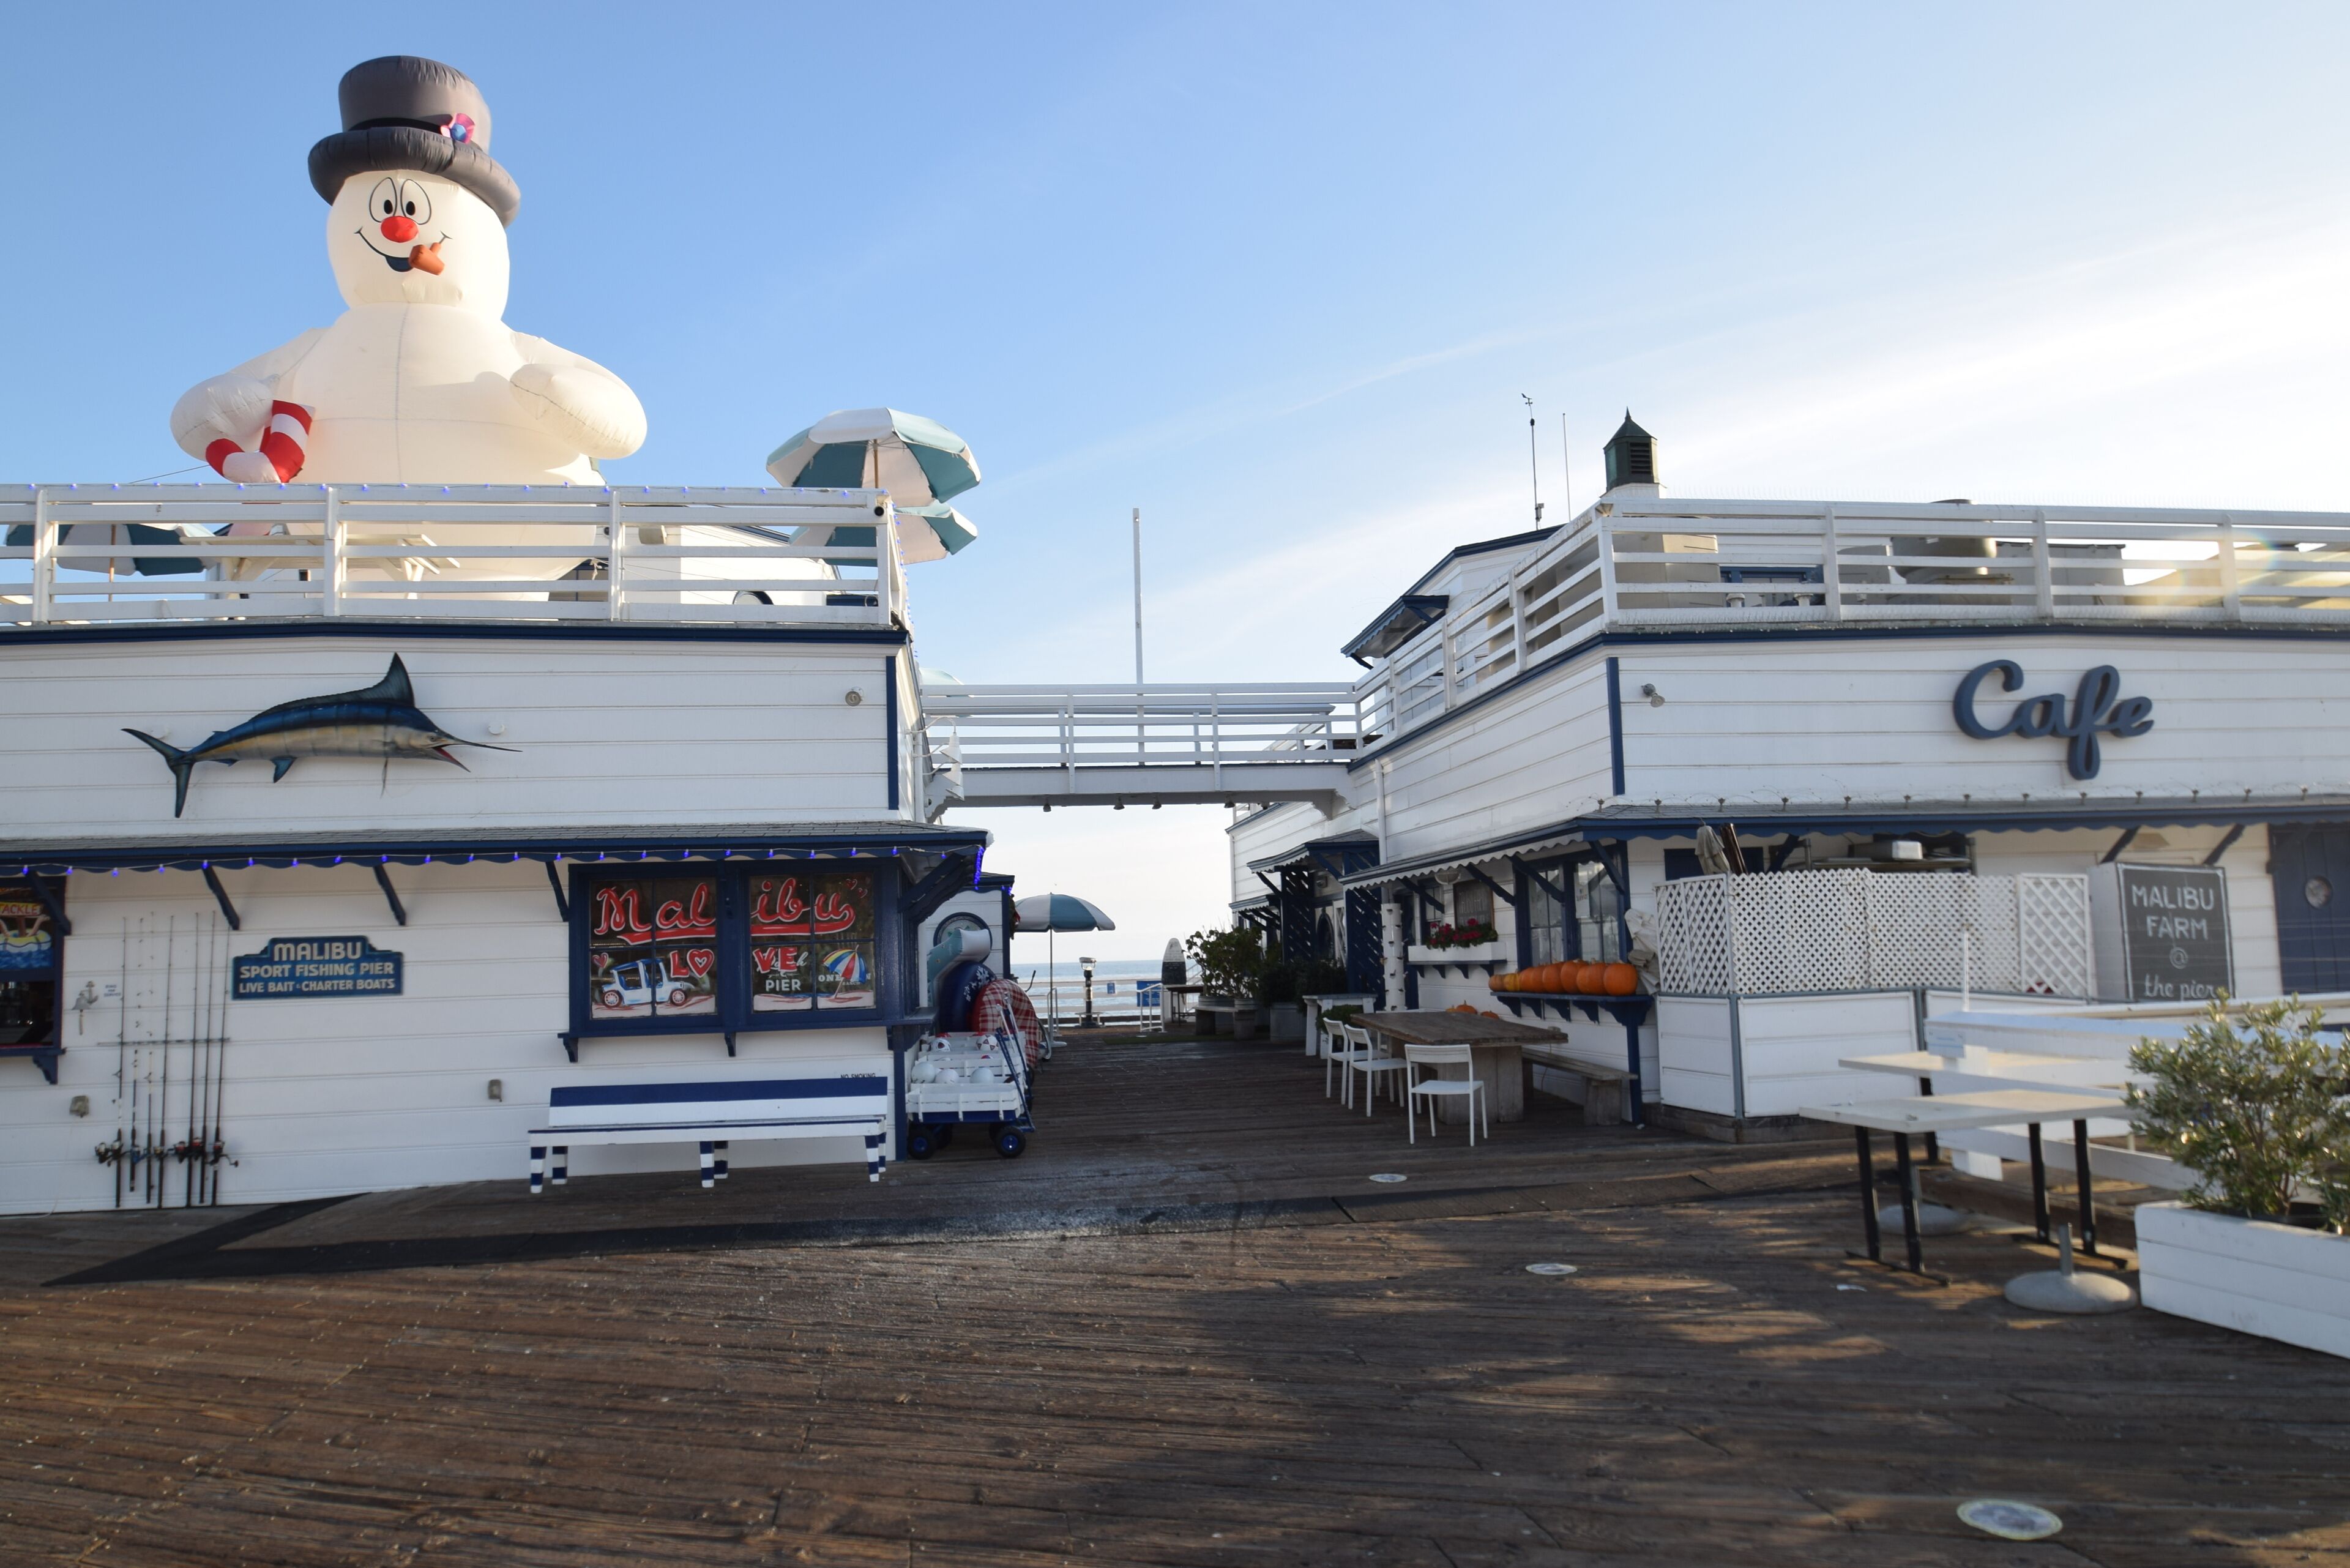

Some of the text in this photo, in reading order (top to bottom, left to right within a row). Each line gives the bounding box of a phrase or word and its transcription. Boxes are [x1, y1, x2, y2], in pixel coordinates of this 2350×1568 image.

[1953, 659, 2155, 780] Cafe
[2132, 885, 2214, 911] MALIBU
[2146, 916, 2208, 940] FARM
[274, 943, 361, 961] MALIBU
[239, 962, 395, 979] SPORT FISHING PIER
[239, 982, 265, 993] LIVE
[268, 982, 295, 992] BAIT
[302, 979, 353, 991] CHARTER
[356, 979, 395, 990] BOATS
[766, 979, 801, 991] PIER
[2144, 973, 2218, 1001] the pier
